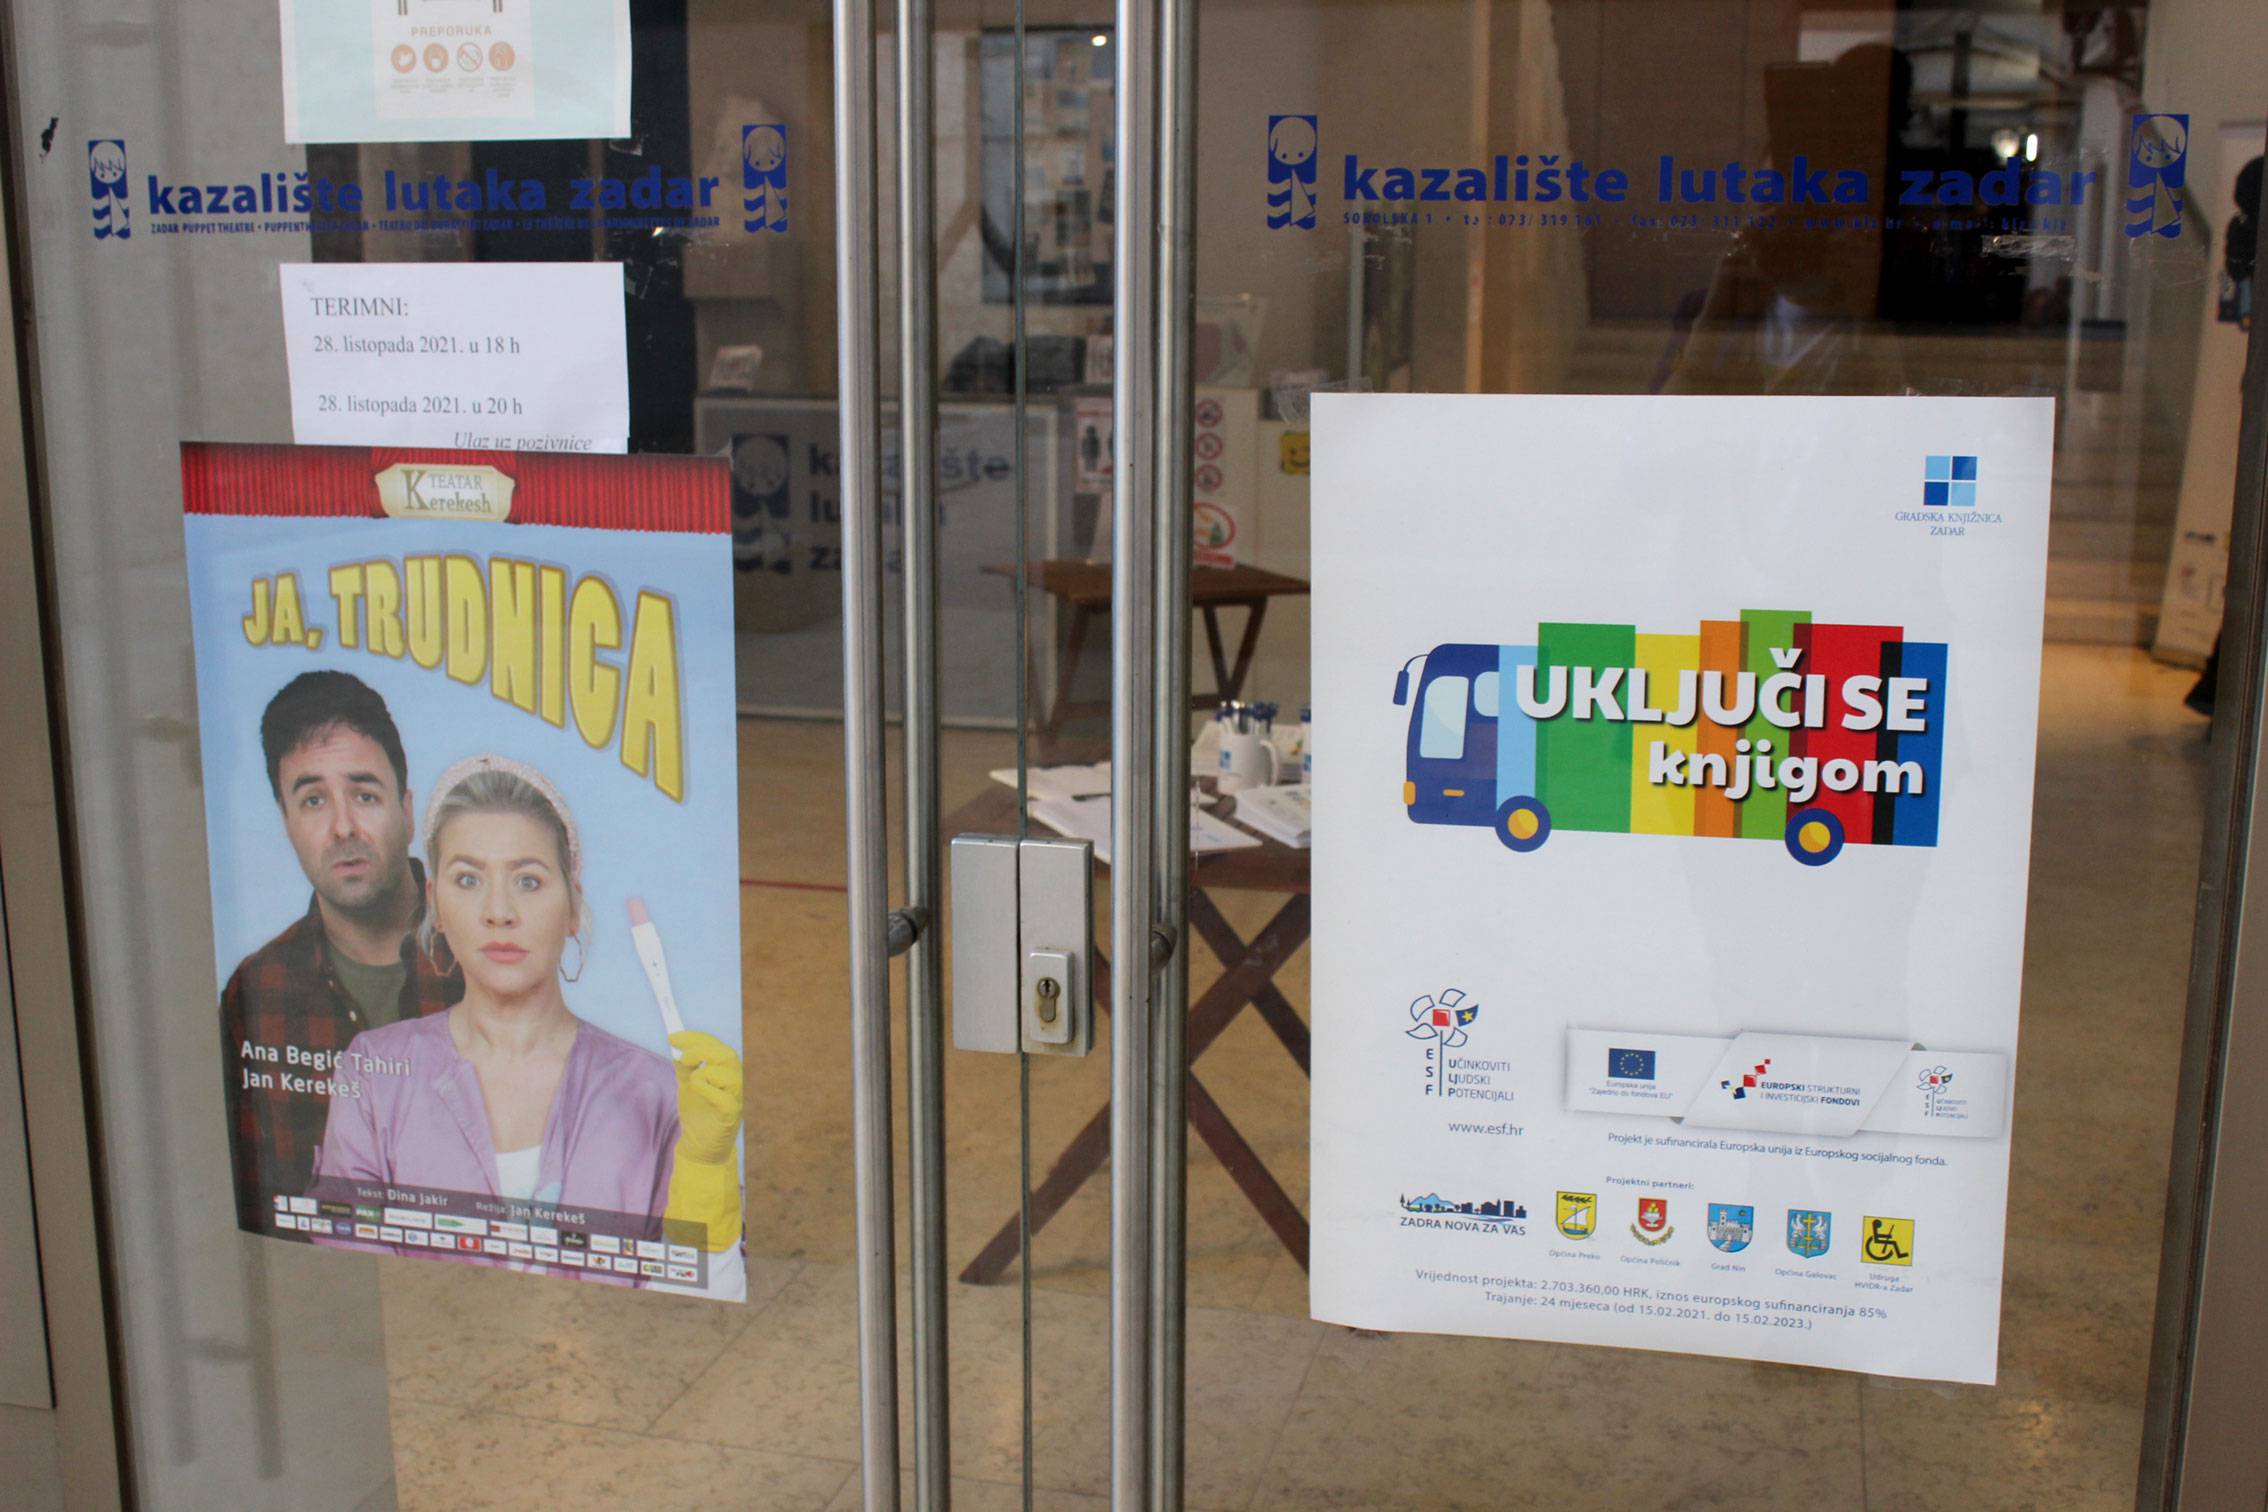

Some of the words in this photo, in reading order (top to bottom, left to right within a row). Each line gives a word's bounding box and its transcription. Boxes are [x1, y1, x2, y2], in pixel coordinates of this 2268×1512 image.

[410, 25, 492, 37] PREPORUKA
[147, 171, 362, 215] kazalište
[385, 167, 546, 212] lutaka
[570, 165, 719, 210] zadar
[1344, 154, 1629, 203] kazalište
[1659, 155, 1869, 205] lutaka
[1898, 156, 2098, 206] zadar
[151, 223, 179, 235] ZADAR
[182, 222, 216, 234] PUPPET
[218, 222, 255, 233] THEATRE
[310, 297, 409, 316] TERIMNI:
[313, 336, 337, 353] 28.
[344, 335, 415, 356] listopada
[419, 336, 464, 353] 2021.
[469, 341, 479, 353] u
[486, 336, 504, 353] 18
[509, 336, 520, 353] h
[318, 395, 342, 412] 28.
[347, 395, 417, 416] listopada
[422, 397, 466, 414] 2021.
[472, 402, 483, 414] u
[487, 397, 507, 414] 20
[513, 397, 523, 414] h
[454, 432, 490, 449] Ulaz
[495, 437, 511, 449] uz
[515, 433, 592, 452] pozivnice
[401, 469, 492, 513] Kerekesh
[430, 473, 483, 490] TEATAR
[1895, 511, 1944, 522] GRADSKA
[1948, 511, 2002, 523] KNJIŽNICA
[1930, 526, 1965, 536] ZADAR
[243, 570, 324, 650] JA,
[328, 553, 686, 804] TRUDNICA
[1515, 646, 1826, 730] UKLJUČI
[1840, 674, 1928, 733] SE
[1648, 738, 1924, 804] knjigom
[240, 1040, 279, 1062] Ana
[286, 1045, 343, 1071] Begić
[351, 1053, 412, 1077] Tahiri
[1448, 1057, 1511, 1072] UČINKOVITI
[243, 1068, 274, 1089] Jan
[281, 1072, 362, 1099] Kerekeš
[1448, 1074, 1491, 1085] LJUDSKI
[1761, 1081, 1805, 1091] EUROPSKI
[1807, 1084, 1861, 1095] STRUKTURNI
[1448, 1087, 1515, 1102] POTENCIJALI
[1821, 1096, 1860, 1106] FONDOVI
[1449, 1122, 1524, 1136] www.esf.hr
[1608, 1132, 1642, 1145] Projekt
[1644, 1134, 1654, 1145] je
[1655, 1135, 1718, 1150] sufinancirala
[1720, 1140, 1765, 1153] Europska
[1768, 1144, 1793, 1156] unija
[1795, 1146, 1803, 1155] iz
[1805, 1146, 1859, 1161] Europskog
[1861, 1151, 1913, 1166] socijalnog
[1915, 1154, 1948, 1166] fonda.
[1606, 1175, 1649, 1187] Projektni
[1652, 1180, 1695, 1191] partneri:
[357, 1187, 384, 1199] Tekst:
[420, 1193, 448, 1207] Jakir
[510, 1205, 531, 1218] Jan
[535, 1208, 586, 1225] Kerekeš
[1400, 1216, 1442, 1229] ZADRA
[1444, 1219, 1480, 1233] NOVA
[1482, 1222, 1499, 1233] ZA
[1503, 1223, 1526, 1236] VAS
[1711, 1262, 1730, 1271] Grad
[1732, 1264, 1746, 1272] Nin
[1416, 1269, 1478, 1285] Vrijednost
[1482, 1274, 1537, 1290] projekta:
[1540, 1279, 1620, 1297] 2.703.360,00
[1623, 1286, 1652, 1300] HRK,
[1656, 1289, 1689, 1302] iznos
[1692, 1293, 1760, 1310] europskog
[1764, 1299, 1856, 1319] sufinanciranja
[1859, 1307, 1888, 1320] 85%
[1485, 1291, 1537, 1306] Trajanje:
[1540, 1296, 1556, 1307] 24
[1559, 1299, 1610, 1312] mjeseca
[1613, 1303, 1635, 1315] (od
[1639, 1304, 1711, 1321] 15.02.2021.
[1714, 1310, 1731, 1322] do
[1735, 1313, 1813, 1330] 15.02.2023.)
